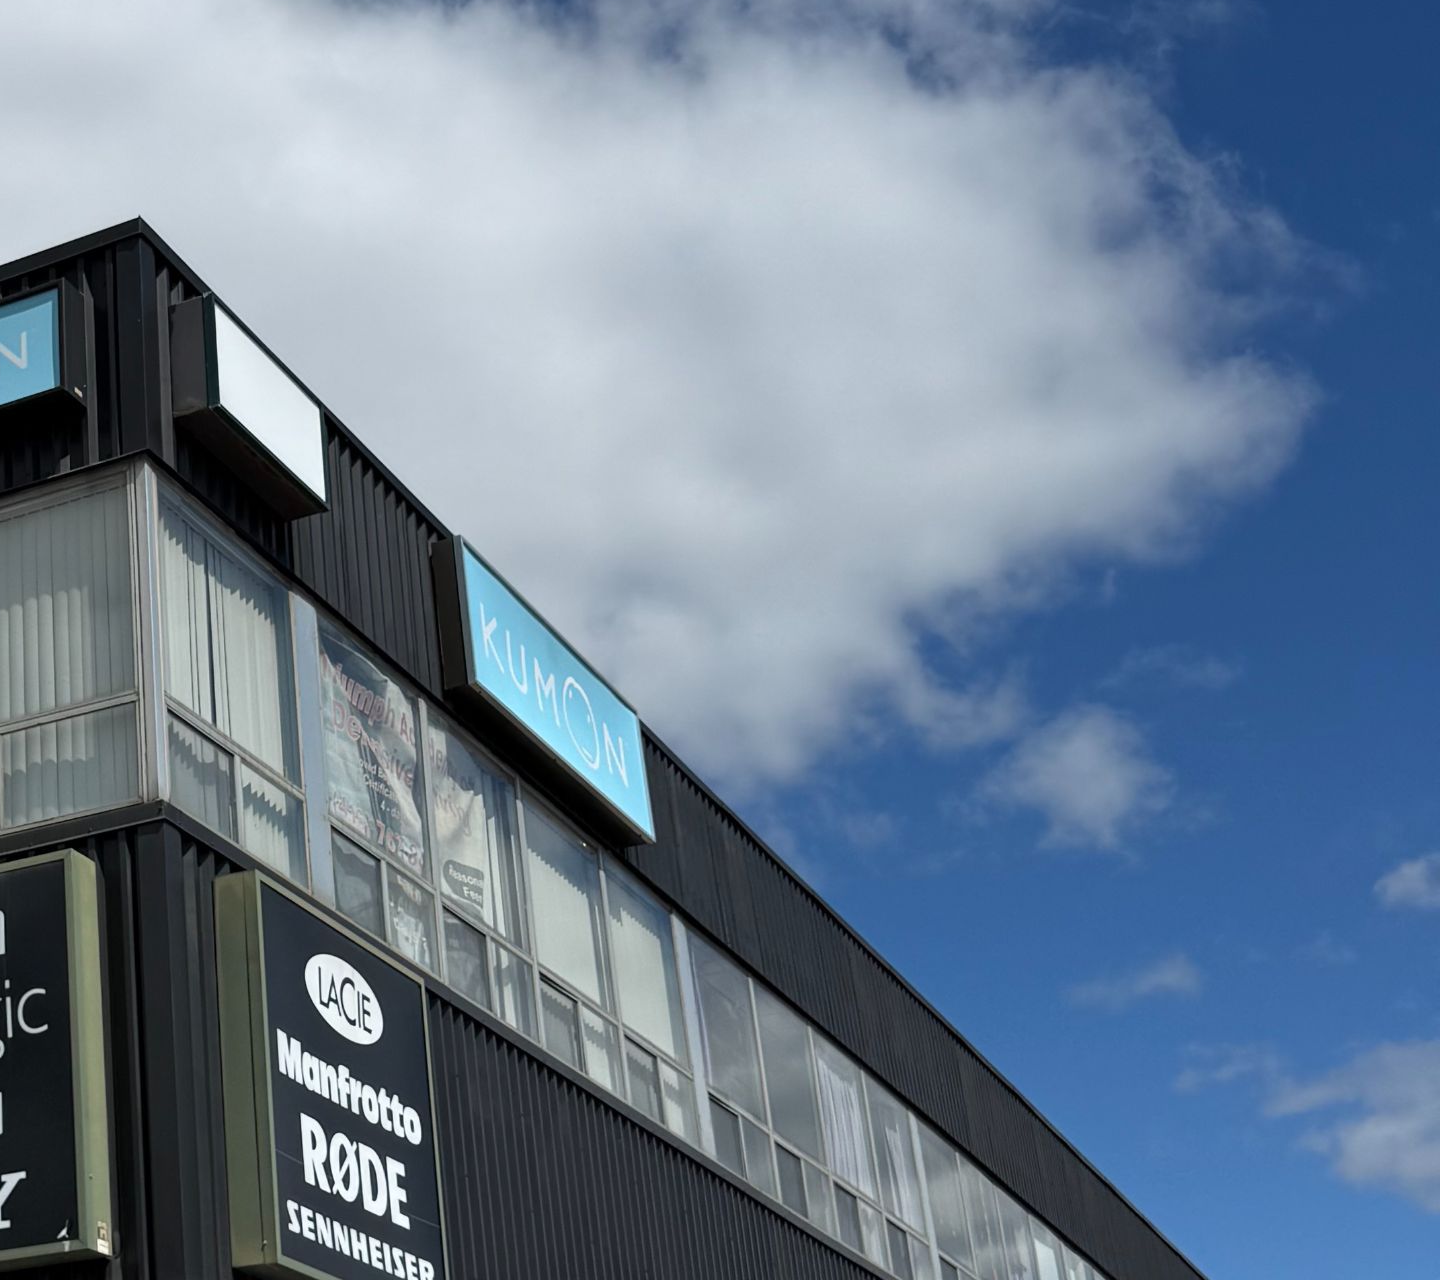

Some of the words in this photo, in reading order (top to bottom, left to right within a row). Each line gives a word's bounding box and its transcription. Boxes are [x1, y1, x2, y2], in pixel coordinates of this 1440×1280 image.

[479, 601, 630, 788] KUMON
[276, 1027, 423, 1146] Manfrotto
[300, 1112, 411, 1231] RØDE
